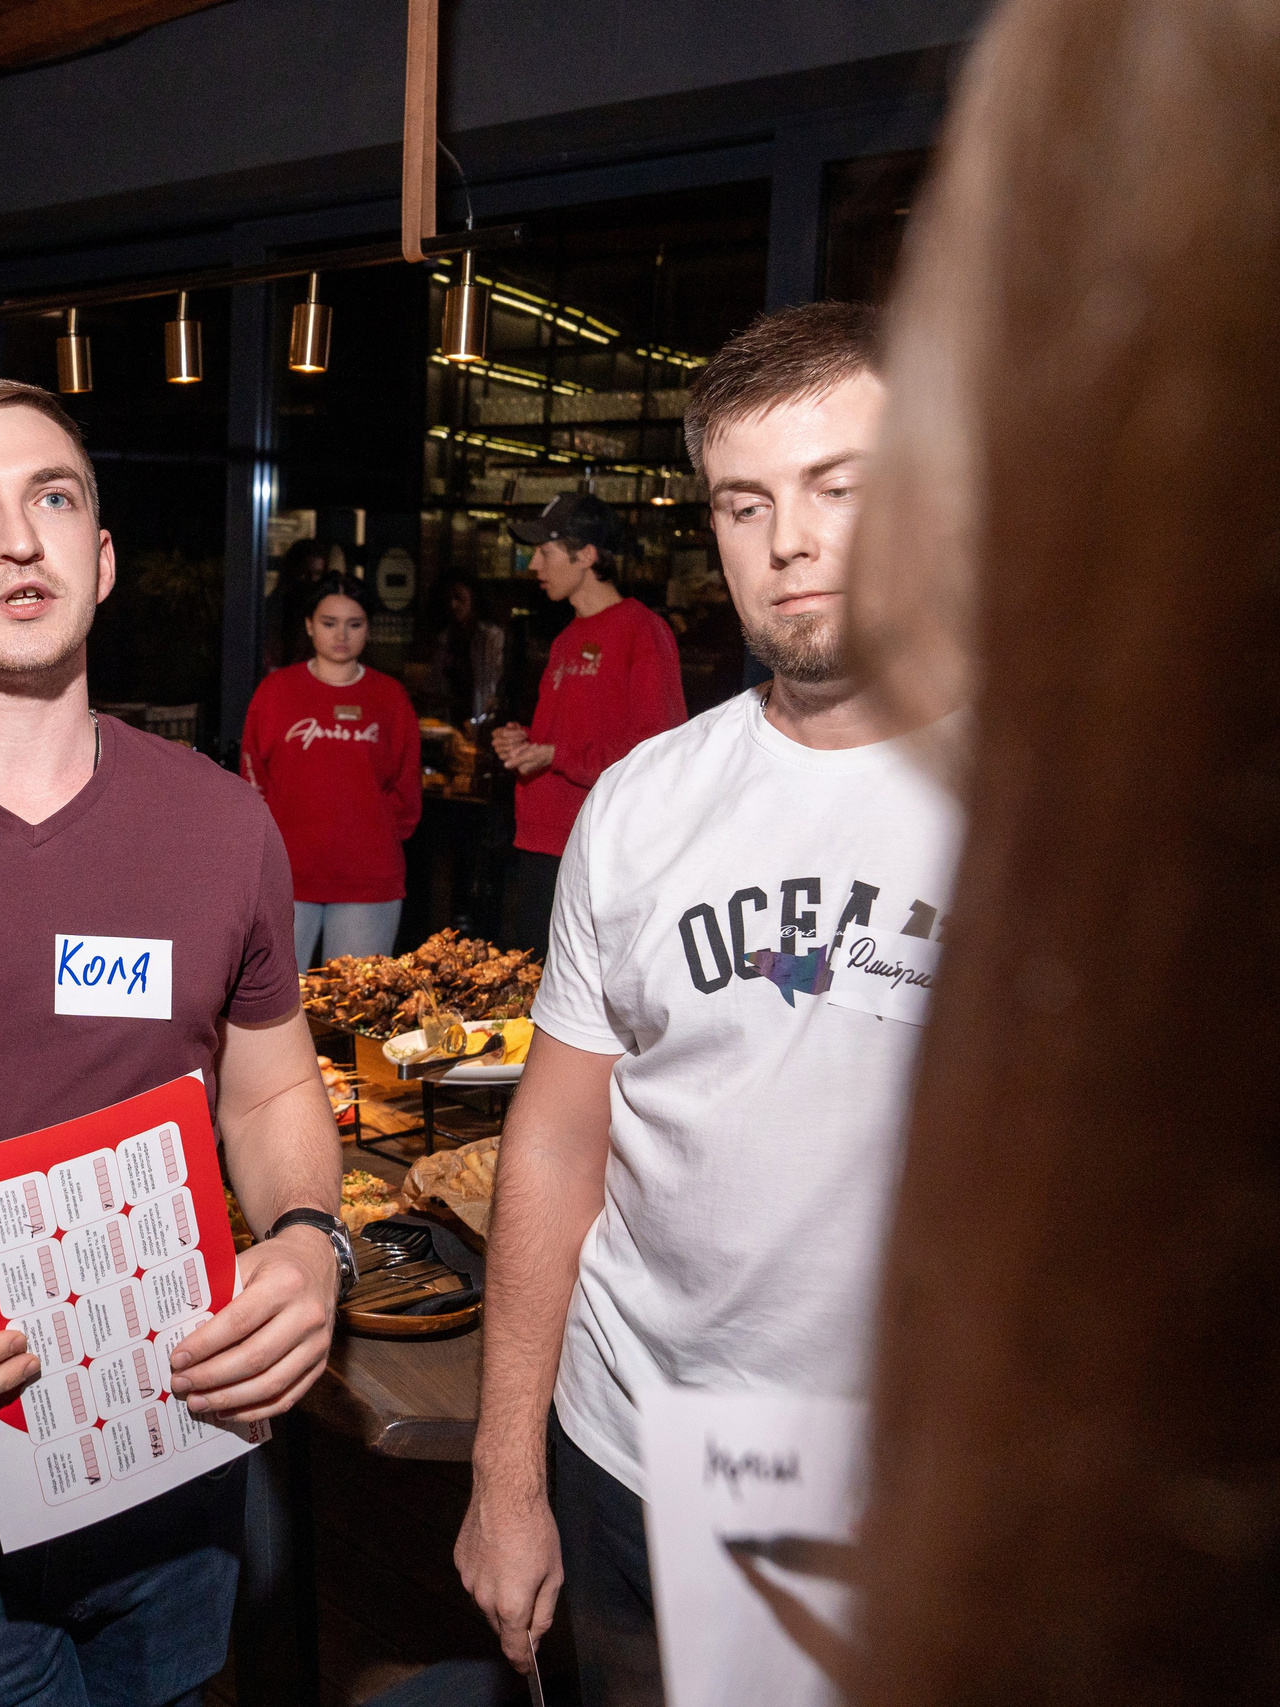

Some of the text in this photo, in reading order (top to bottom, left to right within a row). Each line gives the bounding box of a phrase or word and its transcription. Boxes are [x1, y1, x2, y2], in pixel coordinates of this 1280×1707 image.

[678, 877, 937, 998] OCEA
[847, 937, 933, 989] Дмитри
[58, 939, 150, 995] Коля
